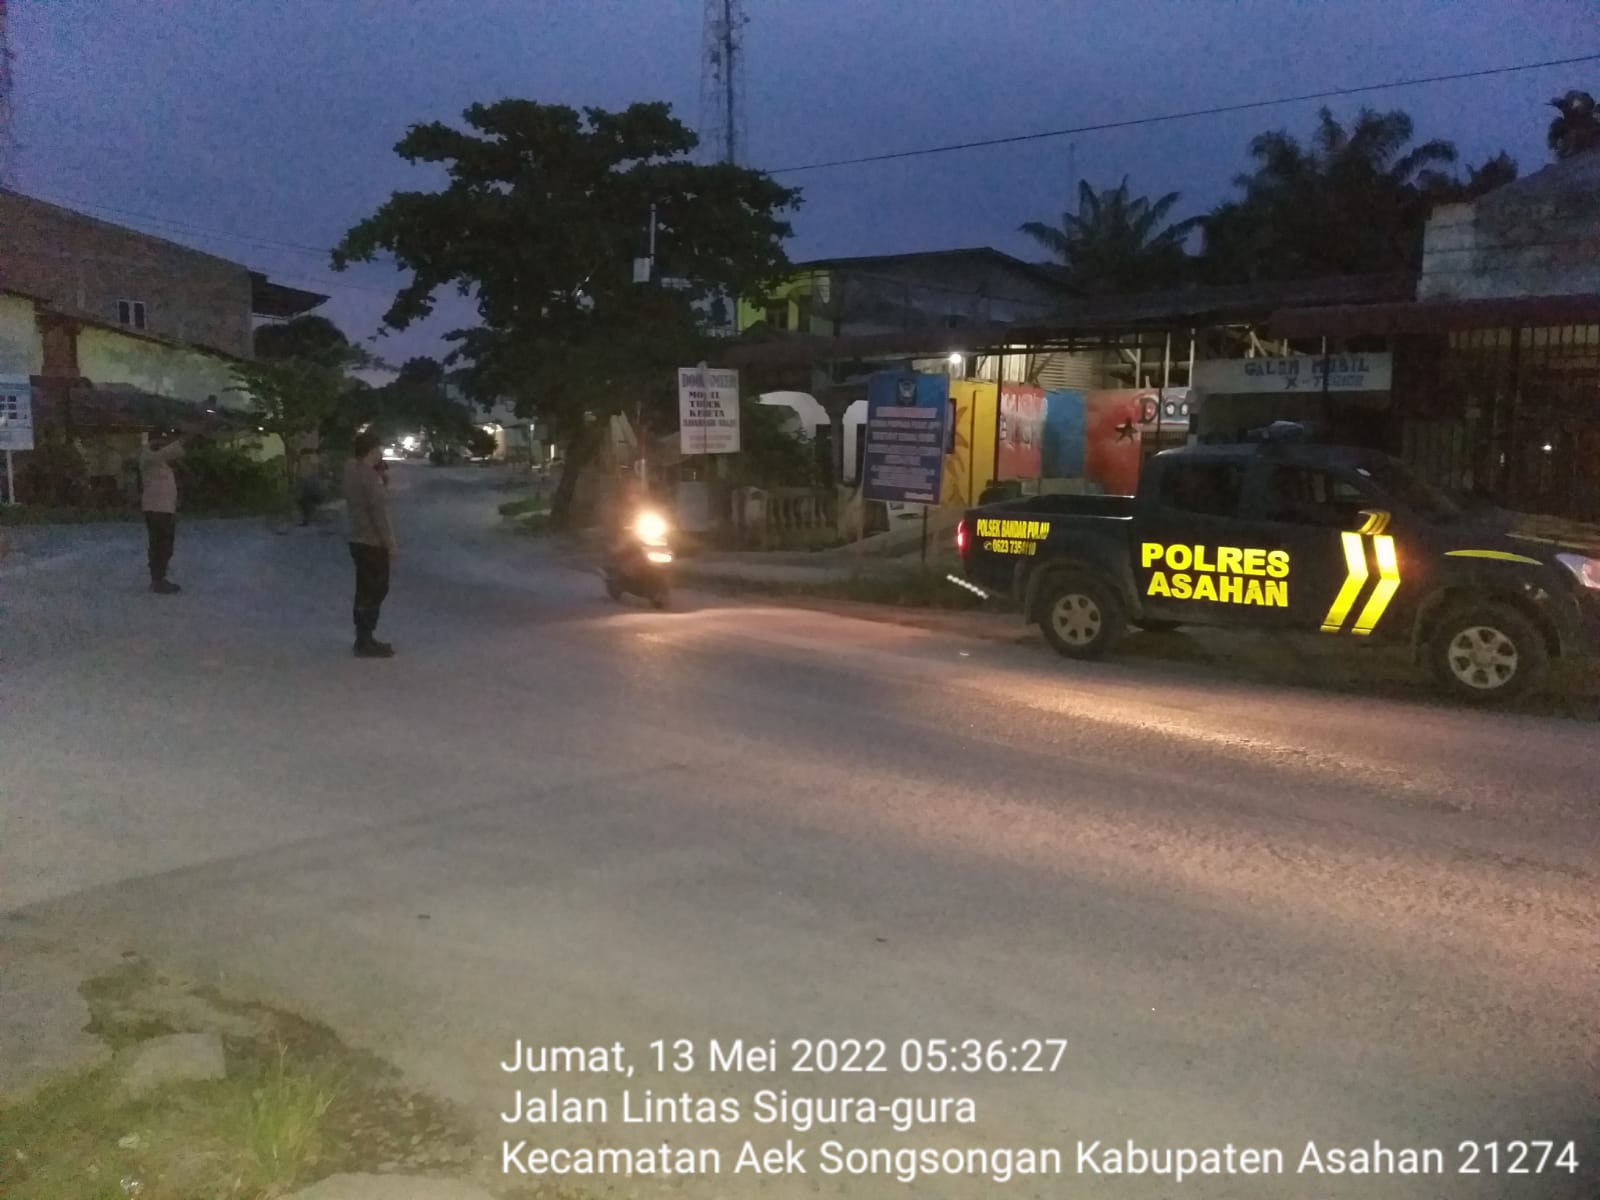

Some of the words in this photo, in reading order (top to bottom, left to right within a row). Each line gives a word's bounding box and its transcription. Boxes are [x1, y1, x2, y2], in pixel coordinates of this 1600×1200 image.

[688, 391, 721, 399] MOIL
[1142, 543, 1290, 578] POLRES
[1147, 571, 1288, 607] ASAHAN
